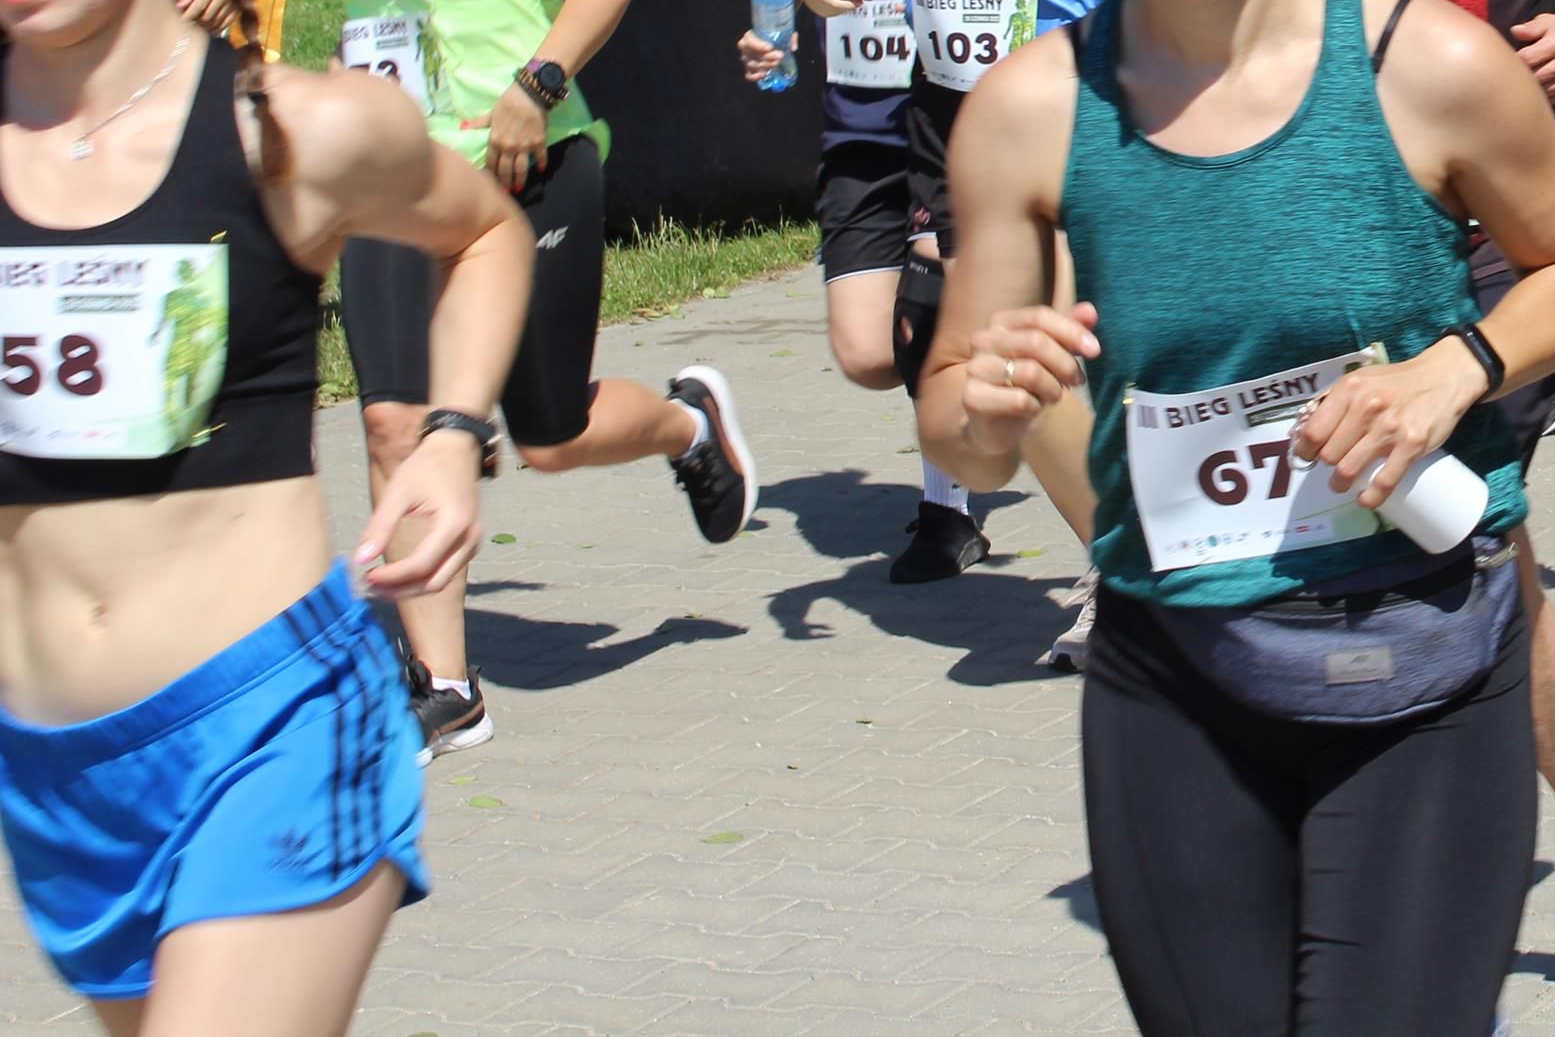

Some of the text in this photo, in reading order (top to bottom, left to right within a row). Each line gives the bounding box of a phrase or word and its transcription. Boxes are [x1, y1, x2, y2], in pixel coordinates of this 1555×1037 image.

[839, 33, 910, 62] 104
[926, 29, 999, 65] 103
[0, 334, 103, 396] 58
[1136, 405, 1159, 429] III
[1164, 397, 1231, 429] BIEG
[1237, 372, 1321, 410] LEŚNY
[1198, 438, 1293, 506] 67
